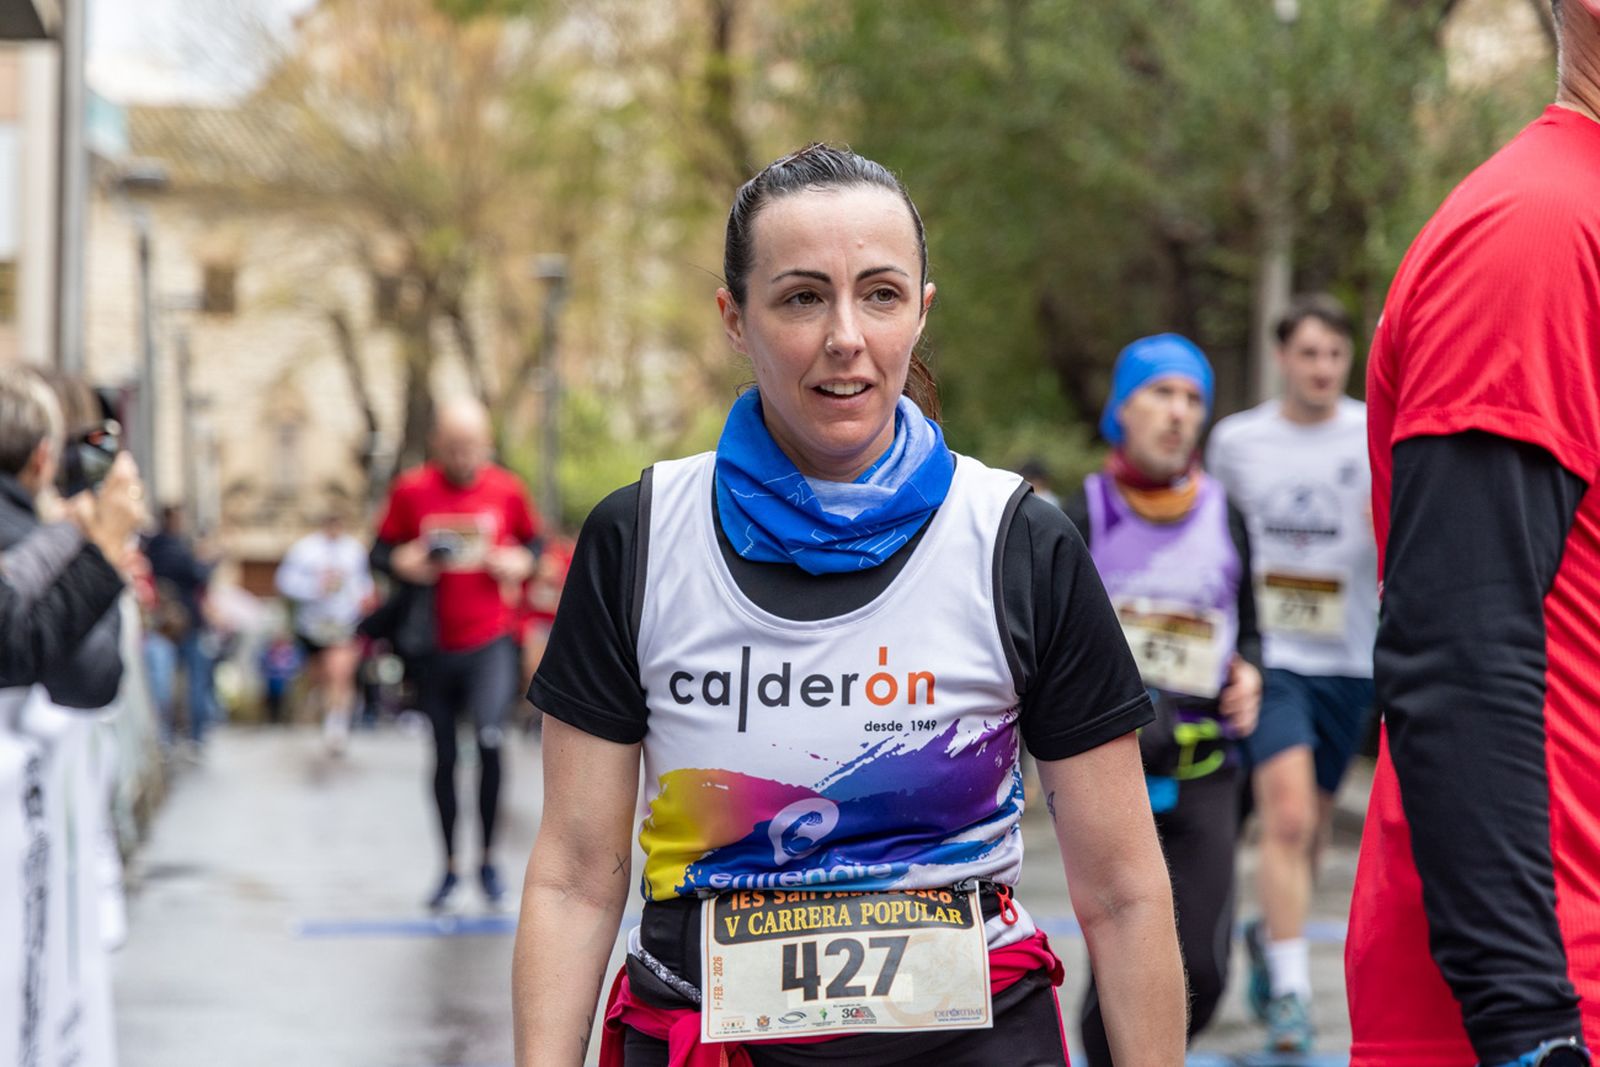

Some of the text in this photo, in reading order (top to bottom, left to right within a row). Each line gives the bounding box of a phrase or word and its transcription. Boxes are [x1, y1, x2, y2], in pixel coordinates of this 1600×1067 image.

[669, 646, 936, 733] calderón
[864, 720, 937, 732] desde 1949
[732, 890, 765, 911] IES
[725, 900, 964, 938] V CARRERA POPULAR
[712, 956, 723, 976] 2026
[782, 935, 910, 1002] 427
